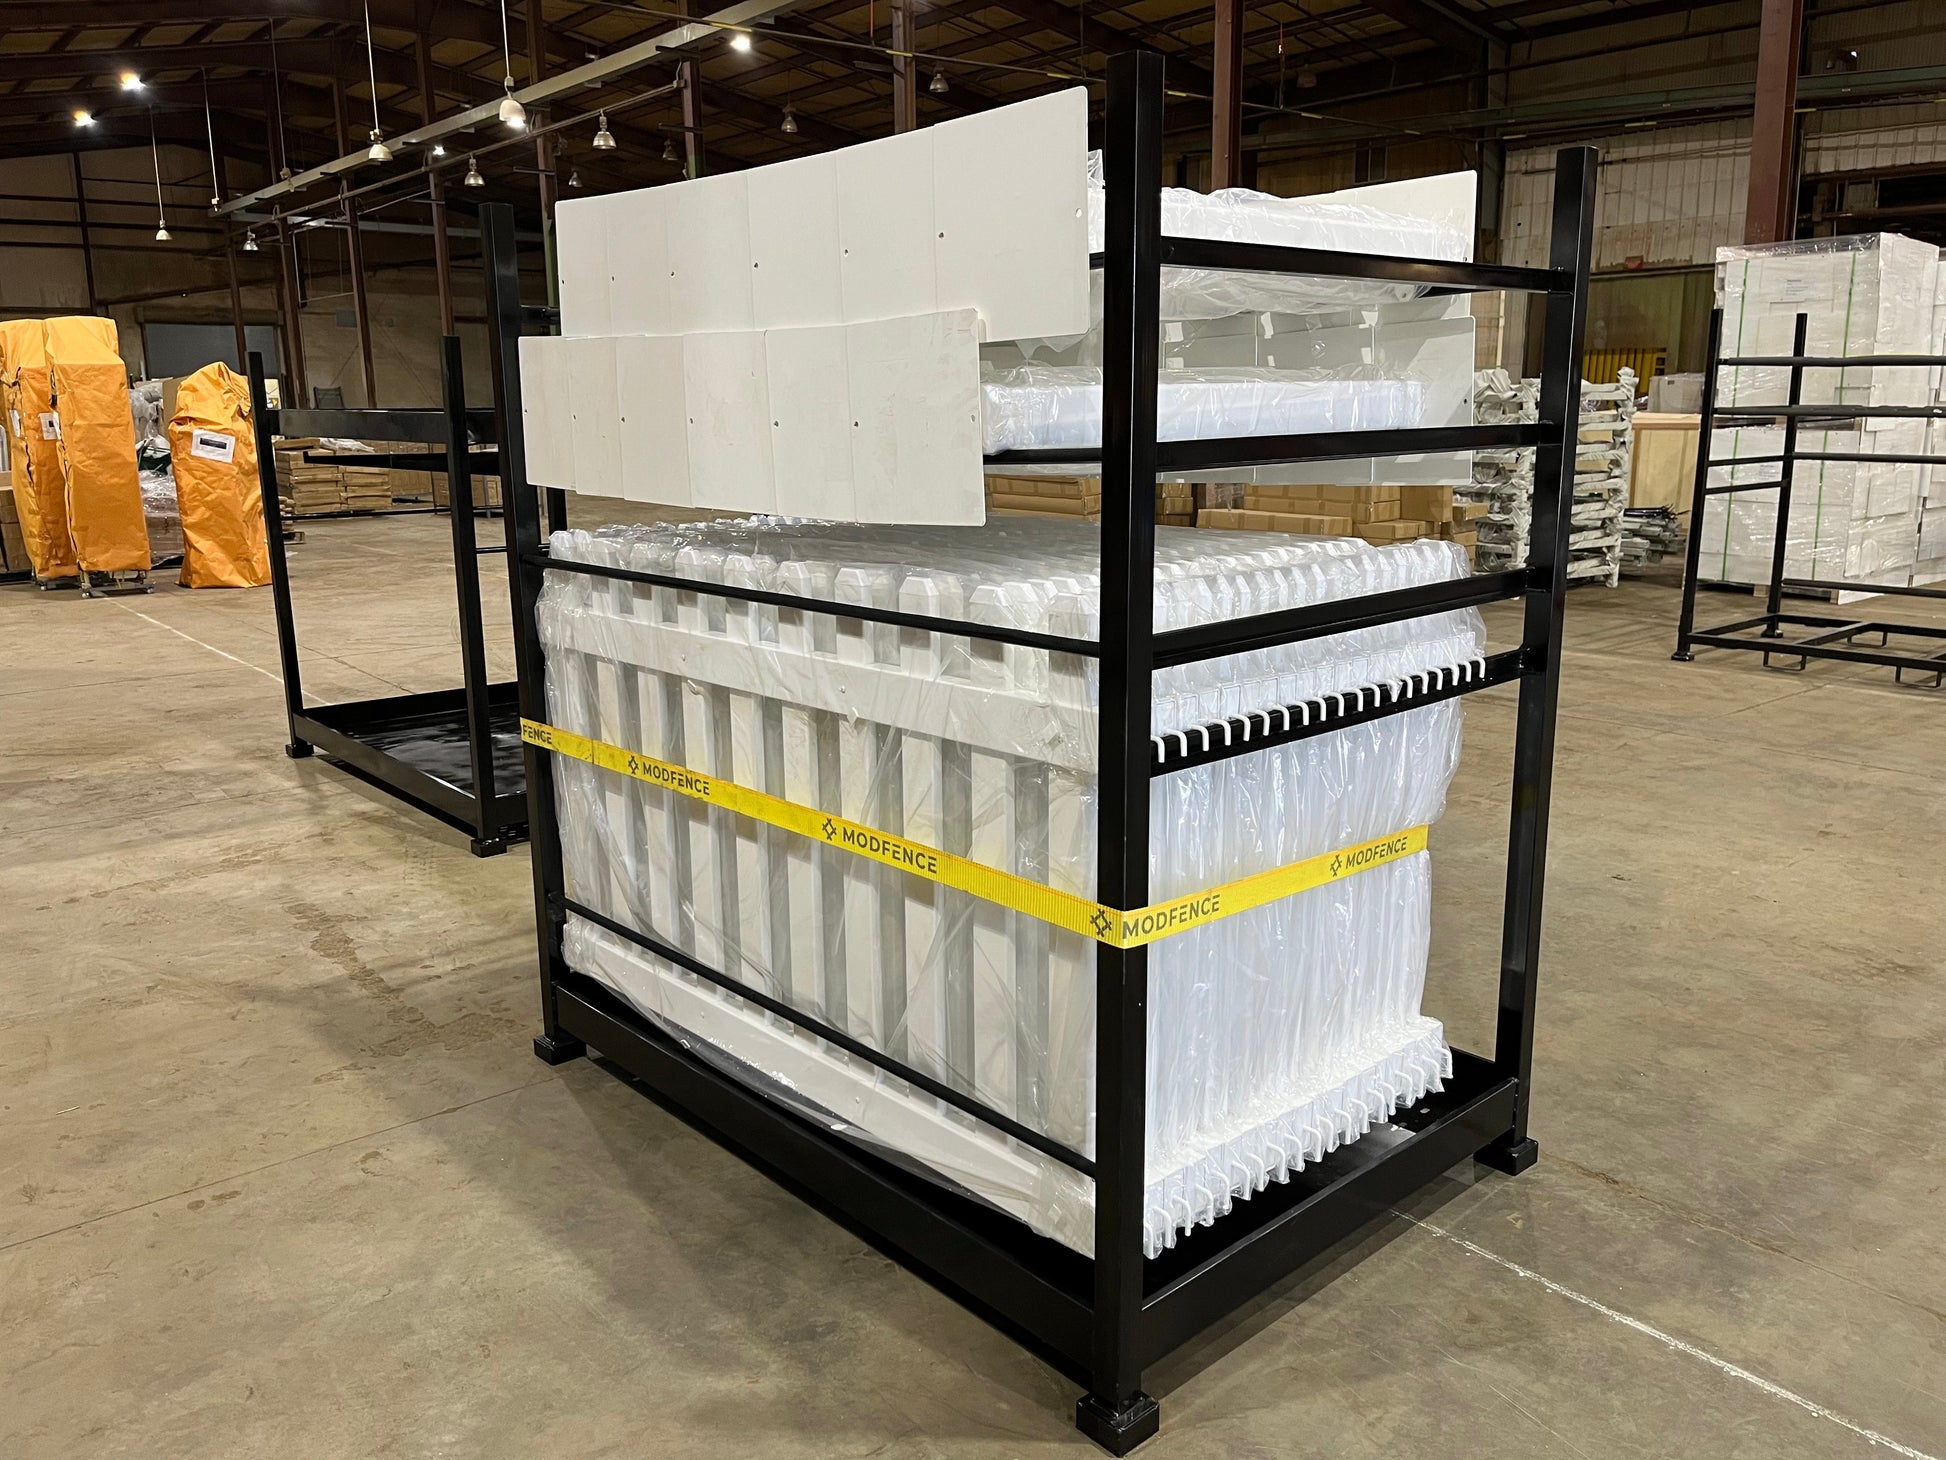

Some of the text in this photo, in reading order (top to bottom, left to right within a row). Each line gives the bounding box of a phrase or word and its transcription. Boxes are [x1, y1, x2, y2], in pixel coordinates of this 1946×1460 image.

[522, 724, 553, 745] FENCE
[643, 762, 710, 796] MODFENCE
[842, 826, 938, 874] MODFENCE
[1346, 836, 1408, 869] MODFENCE
[1122, 894, 1220, 939] MODFENCE
